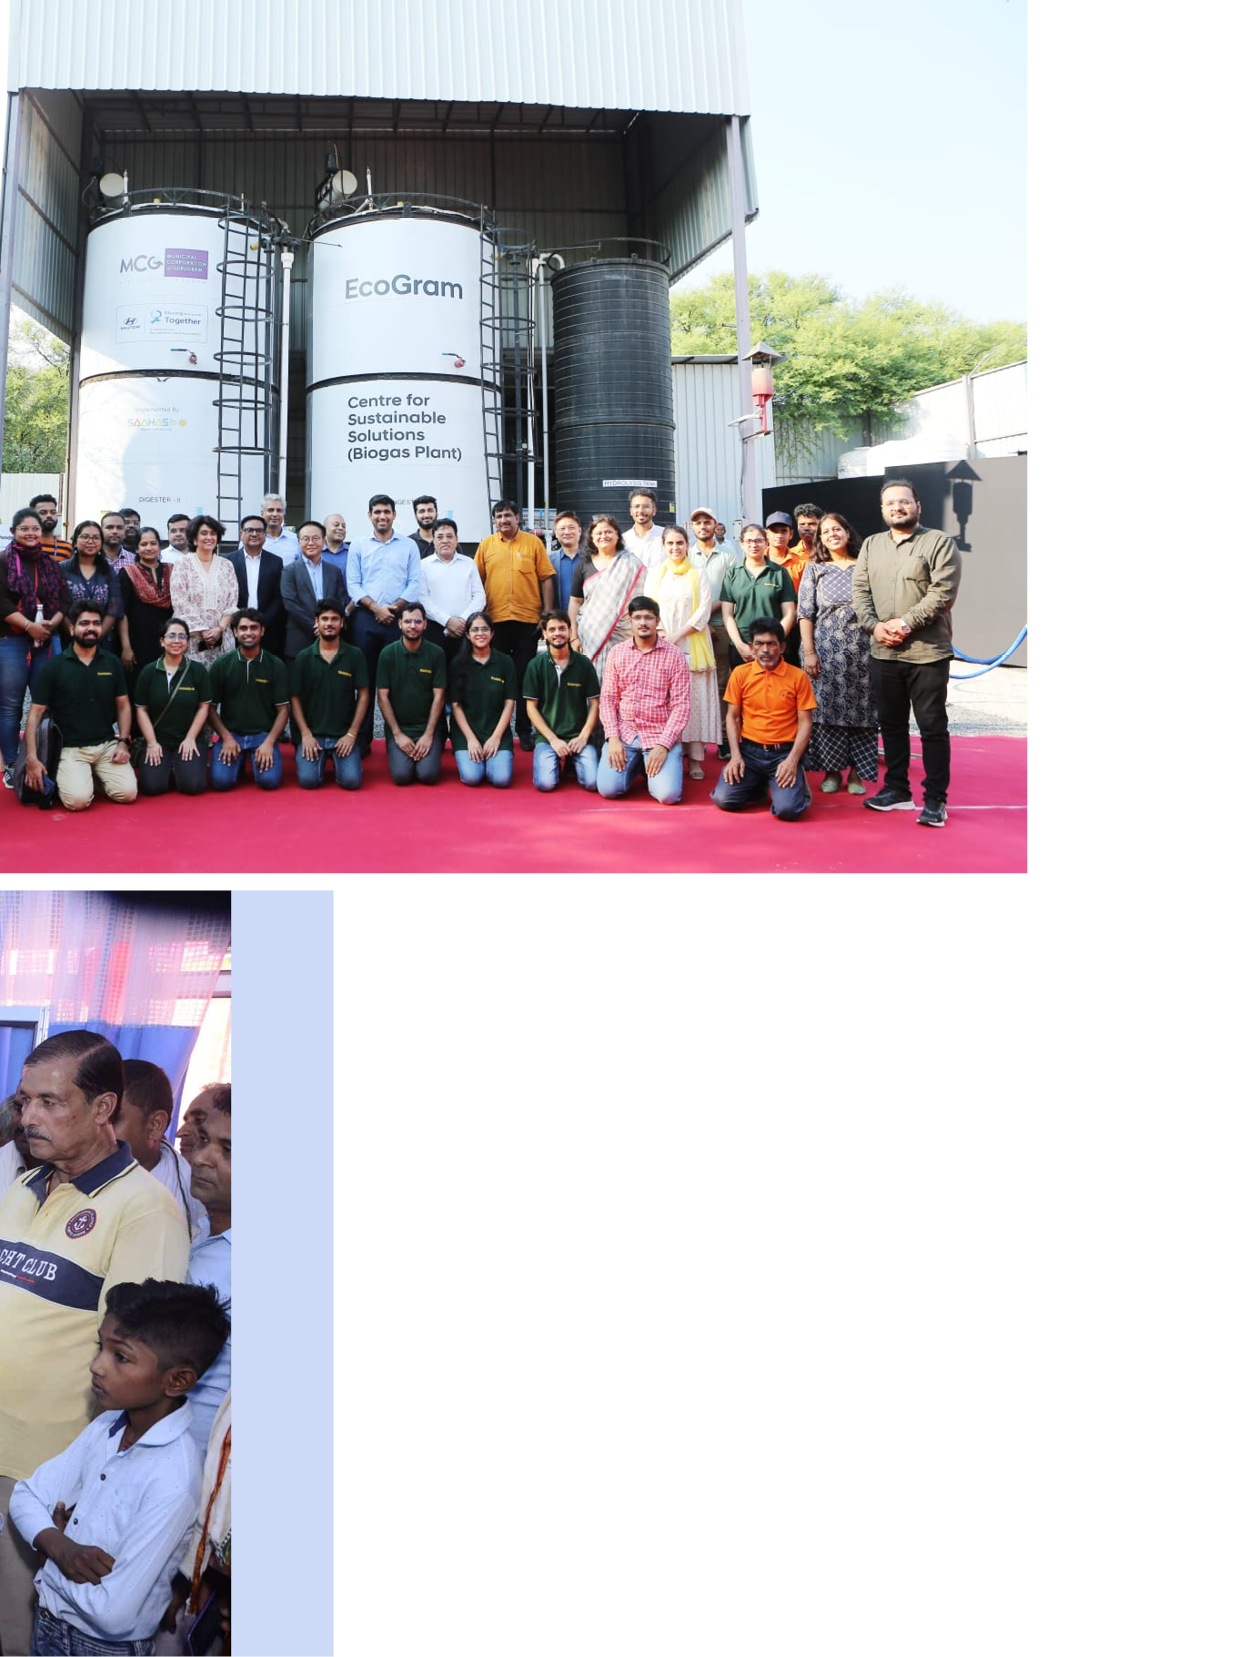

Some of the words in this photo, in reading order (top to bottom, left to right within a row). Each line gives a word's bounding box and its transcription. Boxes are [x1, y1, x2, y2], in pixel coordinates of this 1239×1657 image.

[120, 255, 163, 274] MCG
[345, 274, 463, 299] EcoGram
[165, 317, 202, 326] Together
[347, 396, 402, 409] Centre
[406, 394, 430, 407] for
[347, 410, 446, 426] Sustainable
[347, 428, 425, 443] Solutions
[347, 446, 411, 462] (Biogas
[414, 445, 462, 462] Plant)
[21, 1258, 57, 1281] CLUB
